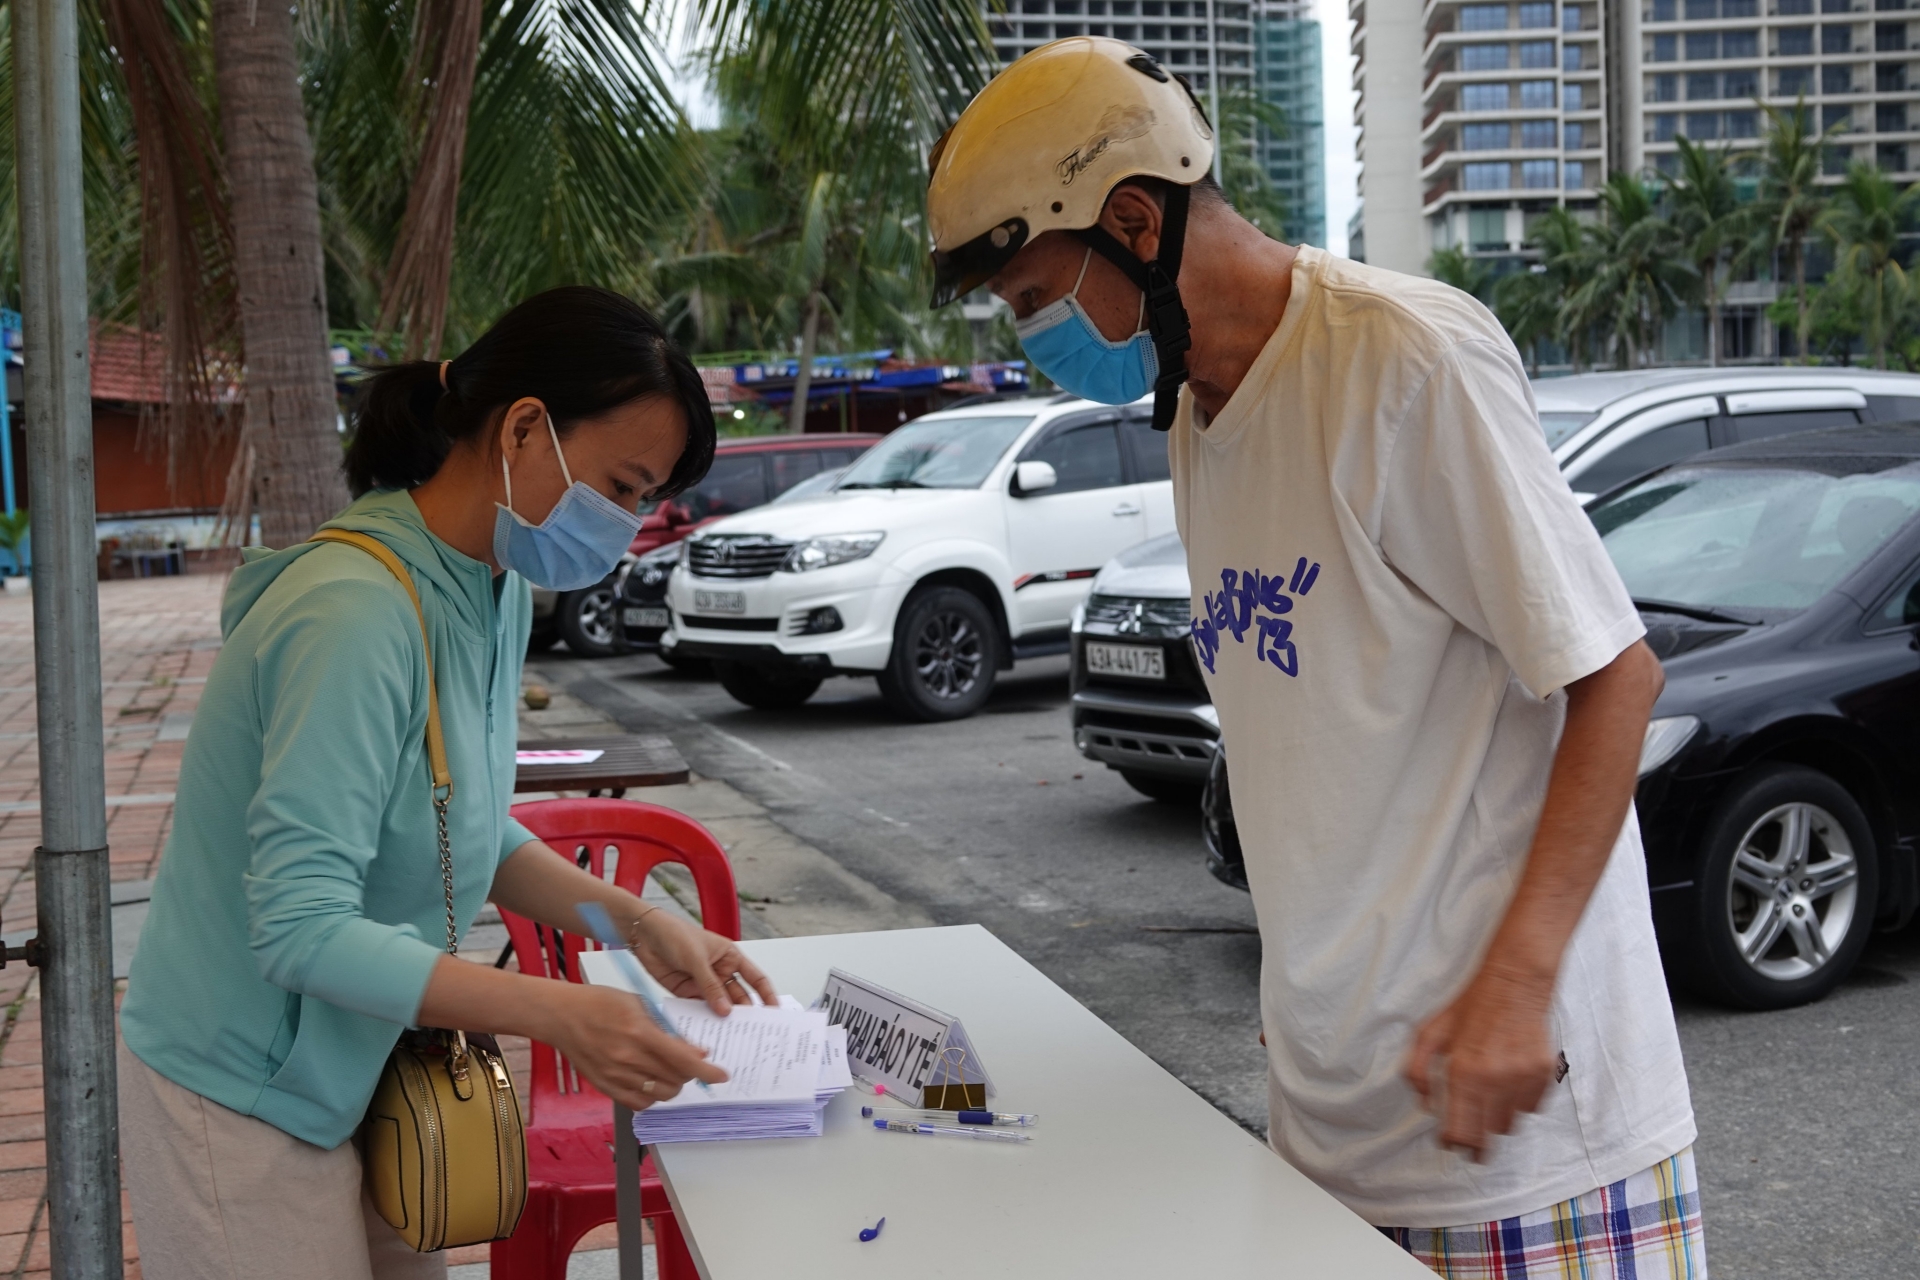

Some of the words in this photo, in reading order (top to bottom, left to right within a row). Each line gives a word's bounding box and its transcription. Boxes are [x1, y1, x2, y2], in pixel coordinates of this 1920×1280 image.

[843, 1005, 878, 1060] KHAI
[865, 1013, 905, 1074] BÁO
[896, 1032, 919, 1079] Y
[907, 1032, 940, 1091] TẾ
